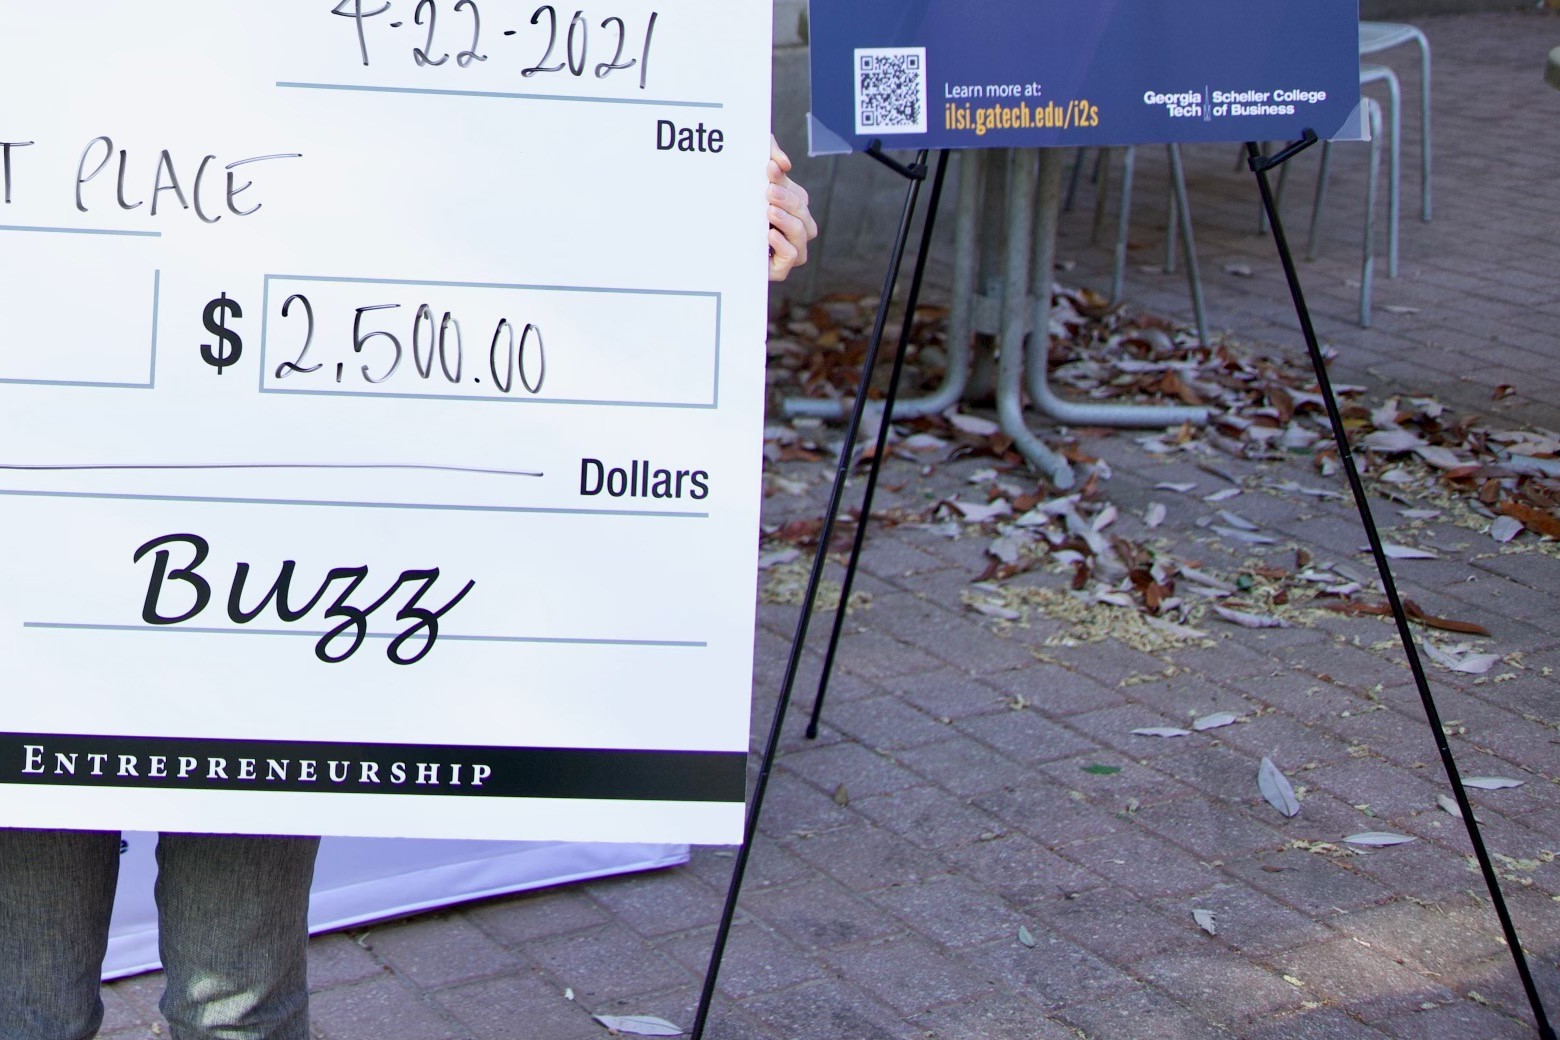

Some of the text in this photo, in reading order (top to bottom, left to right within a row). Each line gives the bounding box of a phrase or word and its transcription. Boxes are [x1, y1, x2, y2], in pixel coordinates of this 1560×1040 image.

[944, 83, 1042, 99] Learn more at:
[1143, 90, 1202, 107] Georgia
[1212, 88, 1327, 104] Scheller College
[1212, 102, 1295, 117] of Business
[944, 99, 1099, 136] ilsi.gatech.edu/i2s
[1166, 104, 1202, 118] Tech
[656, 119, 725, 153] Date
[73, 135, 303, 223] PLACE
[200, 292, 243, 375] $
[274, 294, 546, 394] 2,500.00
[580, 459, 710, 500] Dollars
[133, 532, 476, 666] Buzz
[21, 745, 495, 789] ENTREPRENEURSHIP
